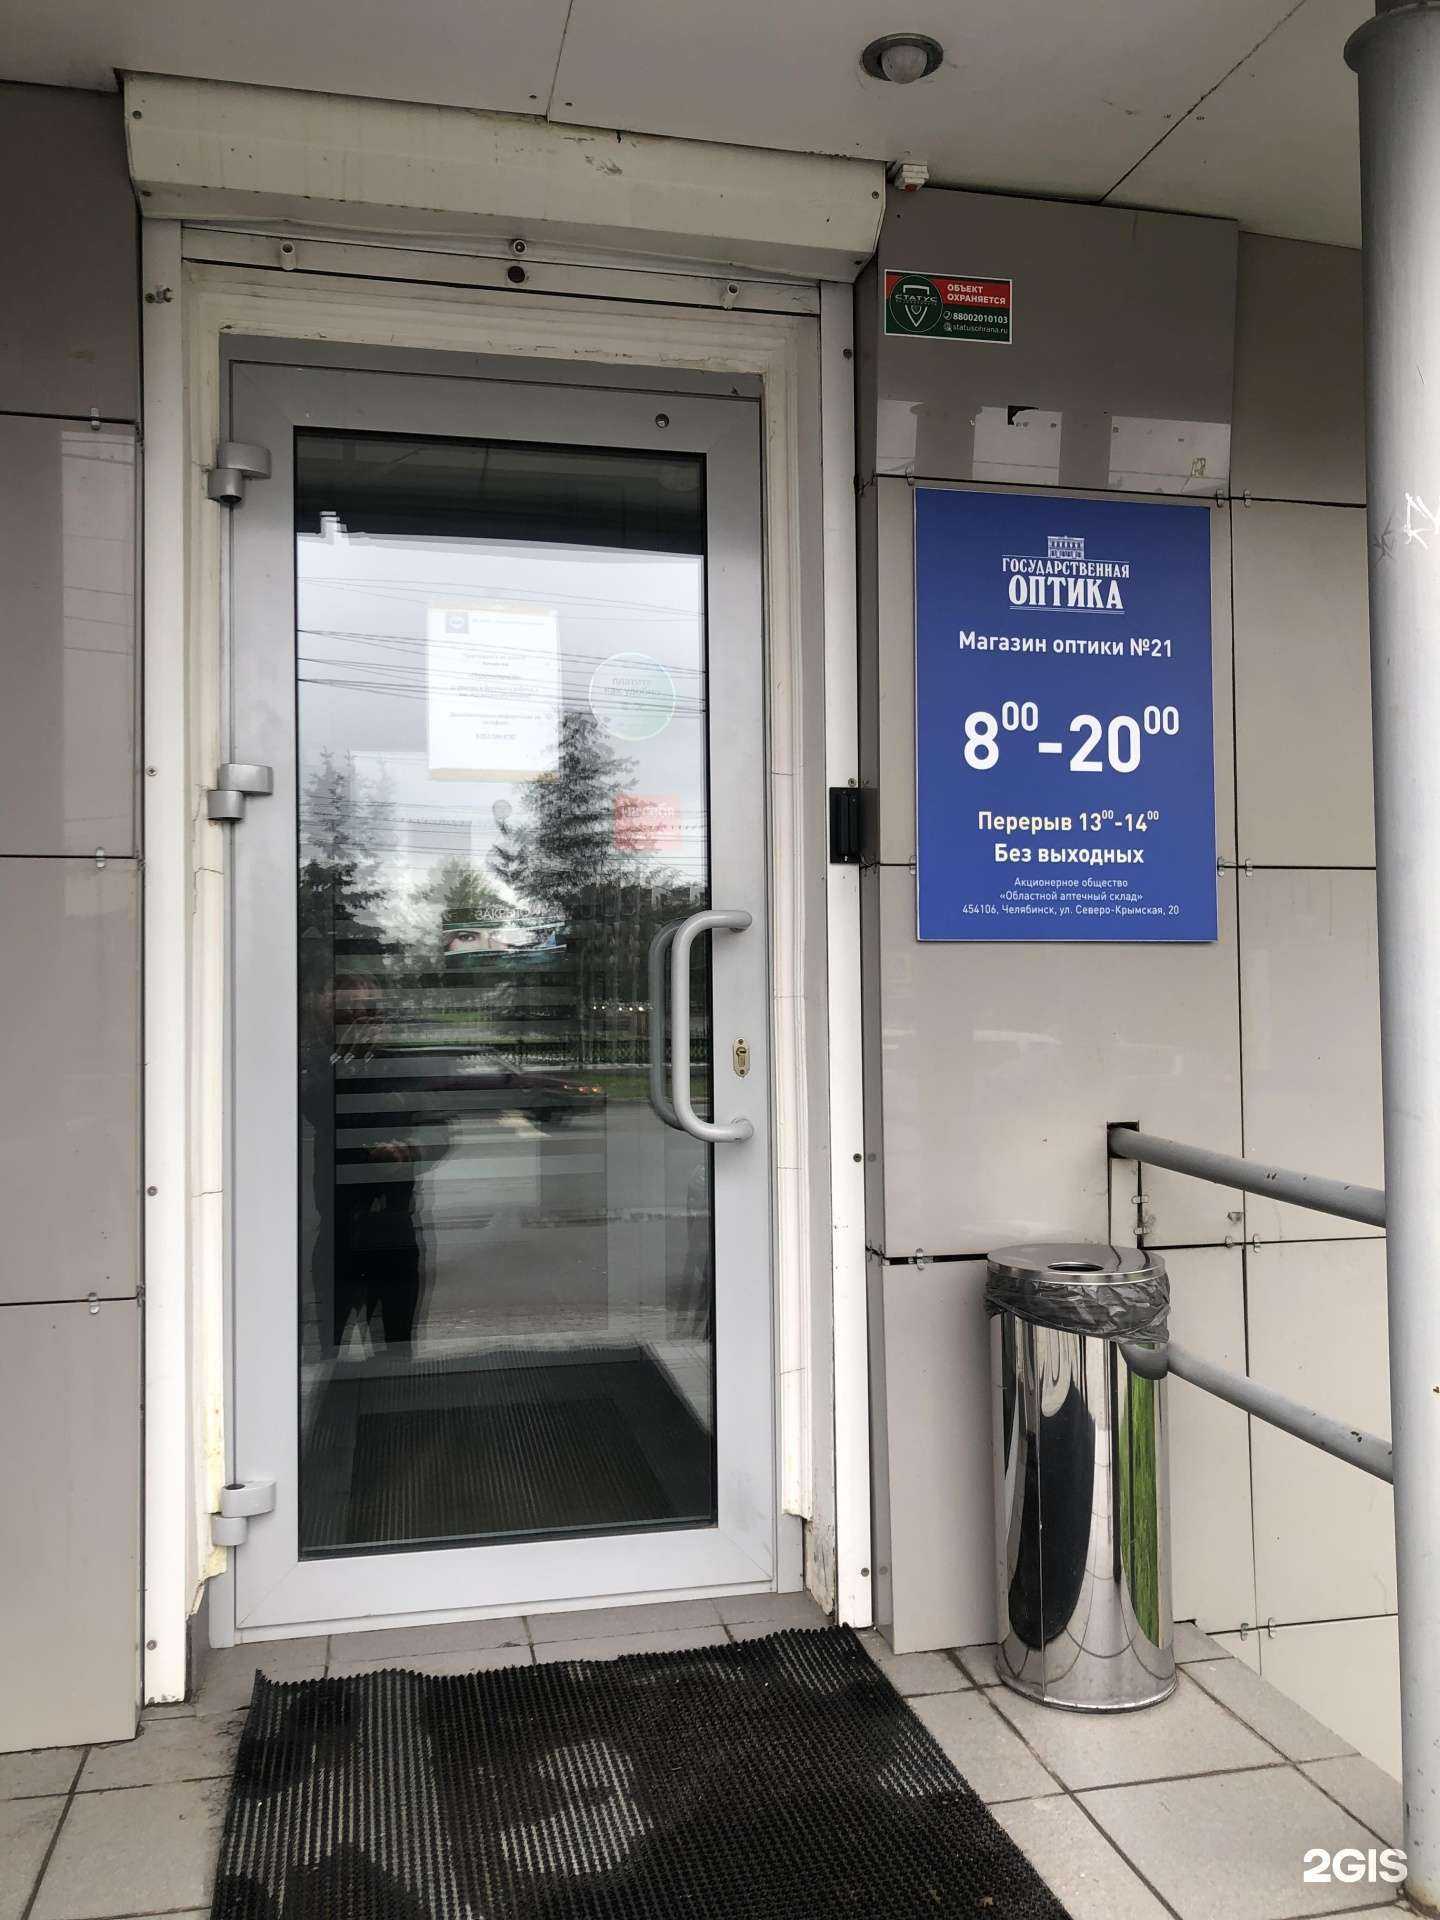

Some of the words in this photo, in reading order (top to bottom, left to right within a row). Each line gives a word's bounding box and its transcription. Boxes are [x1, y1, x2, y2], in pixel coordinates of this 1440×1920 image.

[947, 284, 983, 293] ОБЪЕКТ
[947, 293, 1006, 304] ОХРАНЯЕТСЯ
[952, 312, 1009, 324] 88002010103
[1002, 557, 1130, 579] ГОСУДАРСТВЕННАЯ
[1008, 574, 1124, 610] ОПТИКА
[959, 630, 1047, 654] Магазин
[1053, 638, 1124, 656] оптики
[1130, 638, 1172, 657] №21
[978, 810, 1073, 835] Перерыв
[994, 842, 1032, 863] Без
[1038, 847, 1145, 866] выходных
[1014, 877, 1079, 888] Акционерное
[1081, 877, 1128, 888] общество
[1000, 891, 1058, 901] «Областной
[1060, 891, 1107, 901] аптечный
[1109, 893, 1143, 903] склад»
[962, 904, 999, 916] 454106,
[1001, 904, 1058, 916] Челябинск,
[1059, 906, 1073, 916] ул.
[1075, 905, 1166, 917] Северо-Крымская,
[1168, 905, 1180, 916] 20
